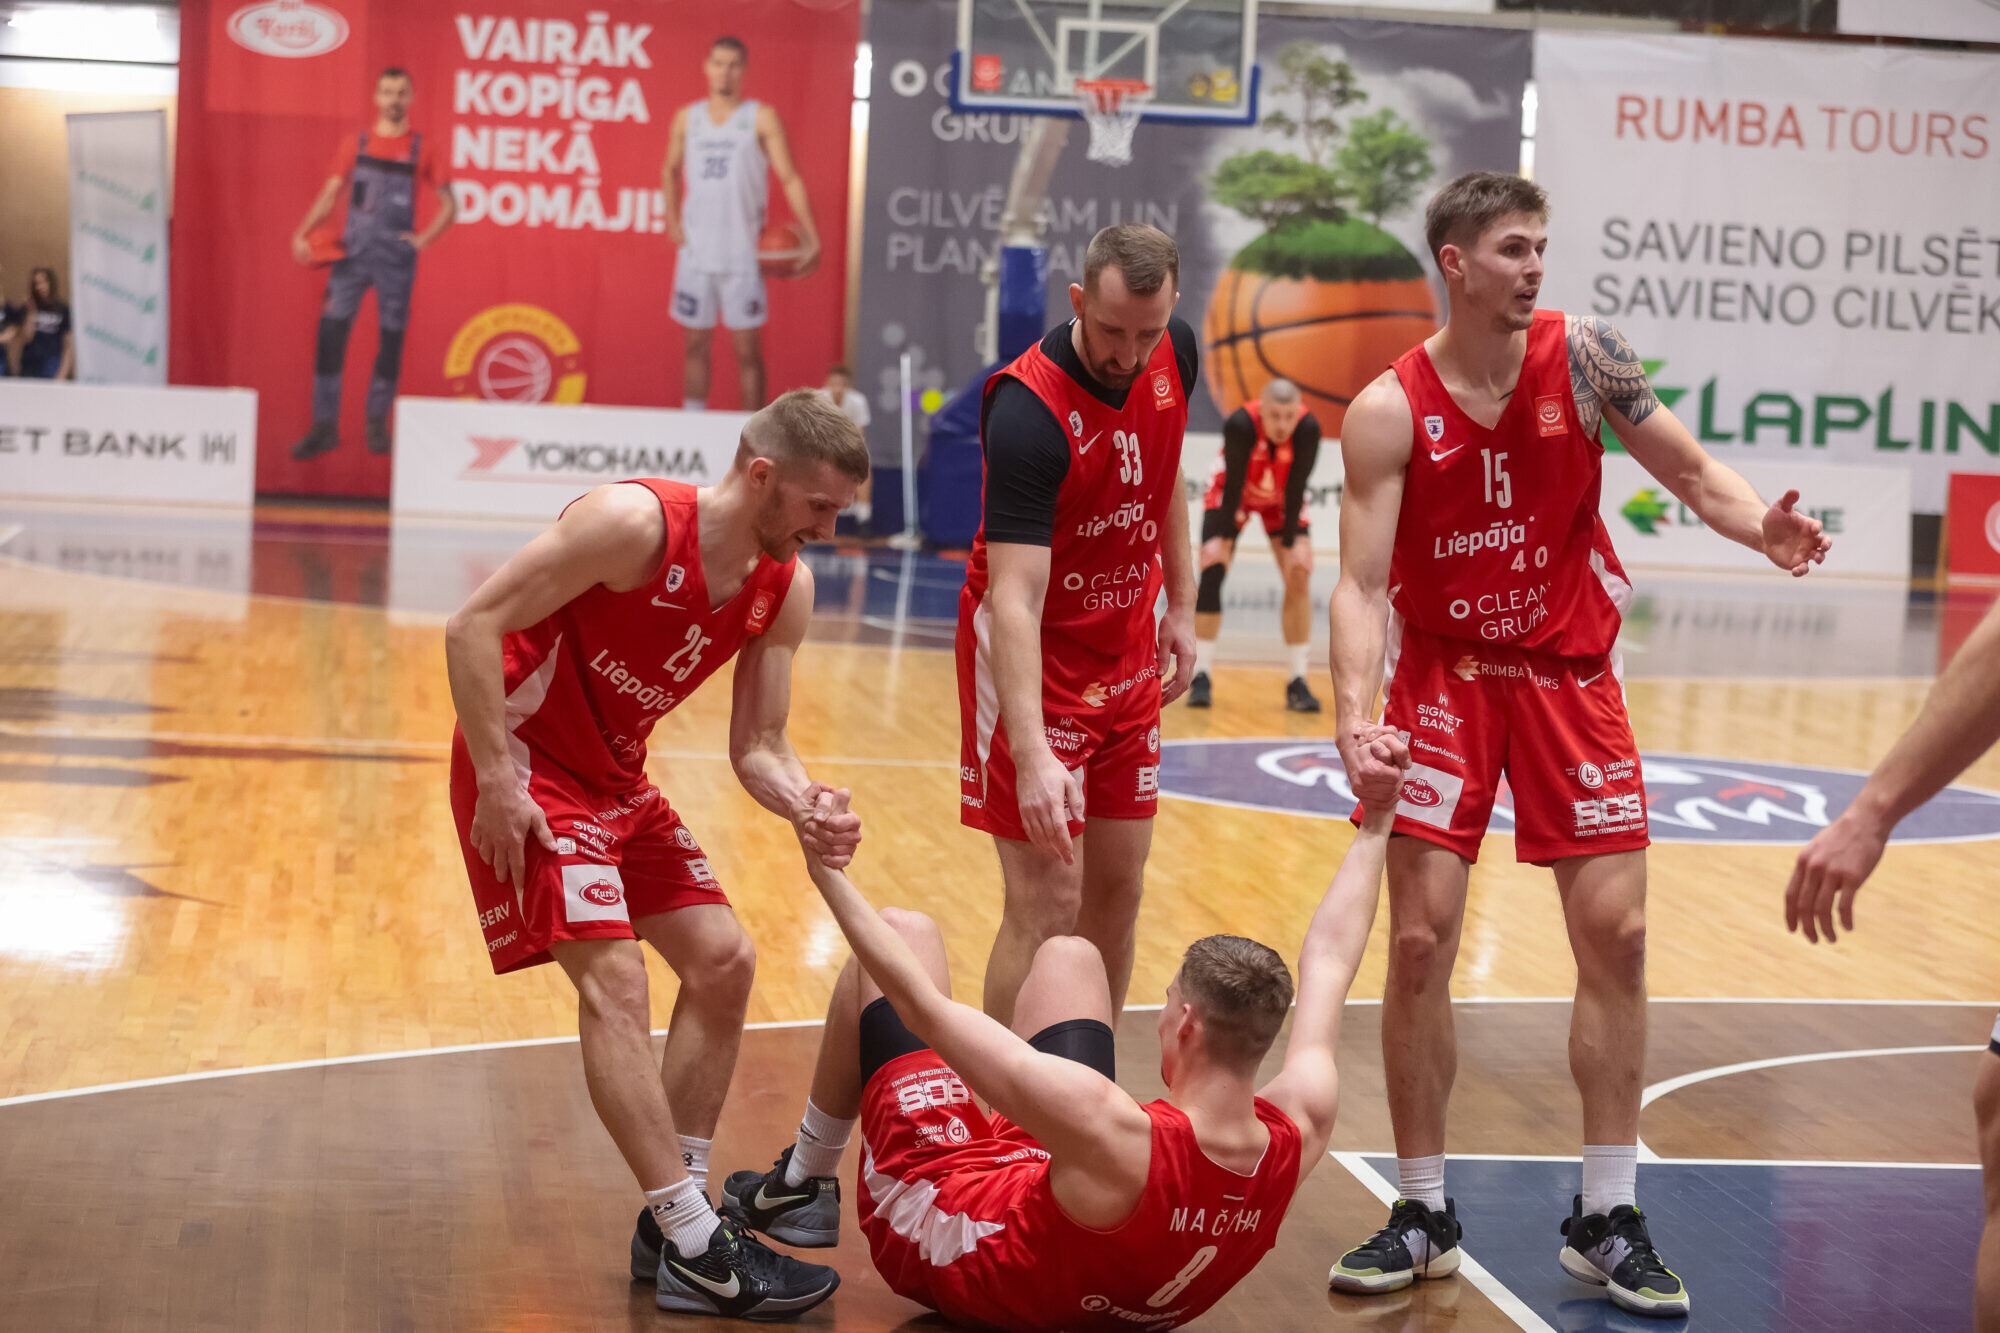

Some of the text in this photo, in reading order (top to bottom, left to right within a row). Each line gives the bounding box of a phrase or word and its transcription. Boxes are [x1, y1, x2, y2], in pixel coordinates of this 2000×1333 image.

[456, 12, 653, 68] VAIRĀK
[454, 67, 650, 123] KOPĪGA
[452, 121, 600, 175] NEKĀ
[1614, 94, 1990, 160] RUMBA TOURS
[453, 178, 667, 234] DOMĀJI!
[887, 185, 1098, 233] CILVĒAM
[1600, 217, 1827, 270] SAVIENO
[1591, 273, 2000, 334] SAVIENO CILVĒK
[62, 427, 187, 460] BANK
[525, 442, 709, 477] YOKOHAMA
[1112, 430, 1143, 486] 33
[1480, 448, 1512, 509] 15
[1434, 519, 1526, 559] Liepāja
[1480, 602, 1549, 640] GRUPA
[589, 649, 676, 710] Liepāja
[662, 624, 712, 682] 25
[1481, 663, 1525, 678] RUMBA
[1416, 704, 1464, 728] SIGNET
[1419, 716, 1455, 737] BANK
[573, 821, 618, 845] SIGNET
[1146, 1245, 1217, 1308] 8
